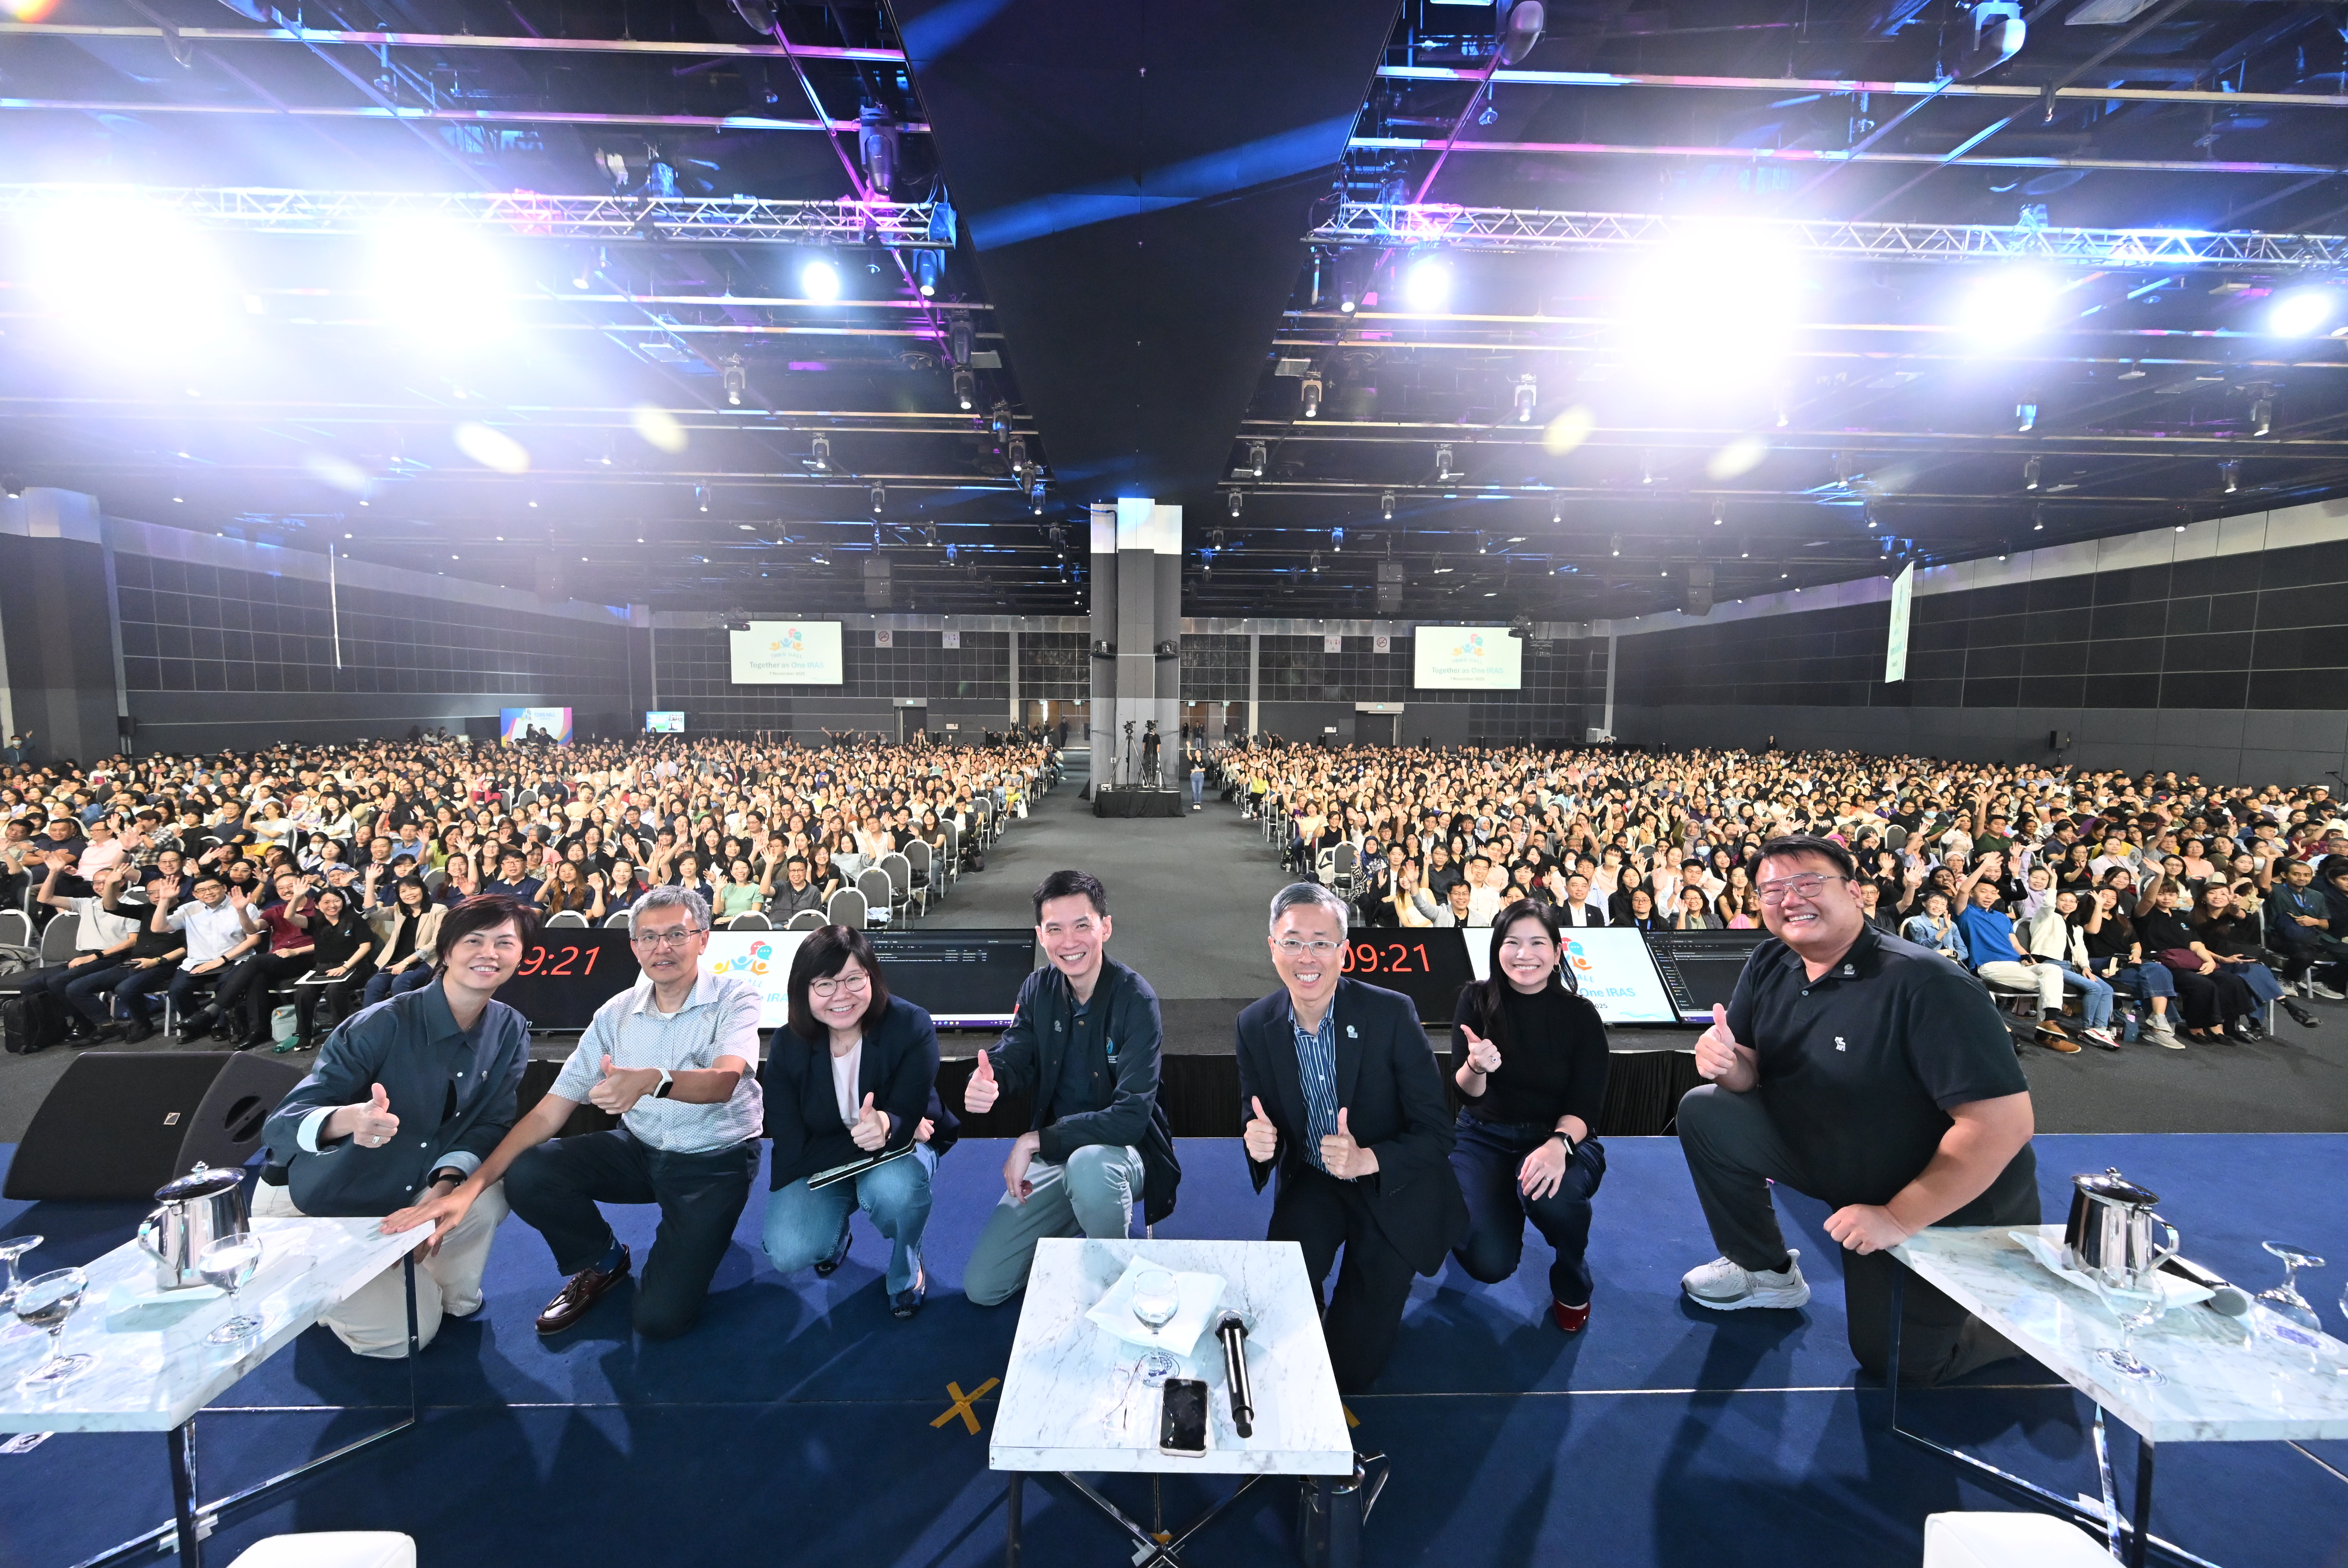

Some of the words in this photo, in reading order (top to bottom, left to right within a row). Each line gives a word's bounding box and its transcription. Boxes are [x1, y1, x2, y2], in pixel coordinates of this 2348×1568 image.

[518, 946, 600, 975] 9:21
[1577, 974, 1594, 983] ALL
[747, 979, 763, 988] ALL
[766, 993, 789, 1002] IRA
[1580, 988, 1604, 998] One
[1607, 988, 1636, 997] IRAS
